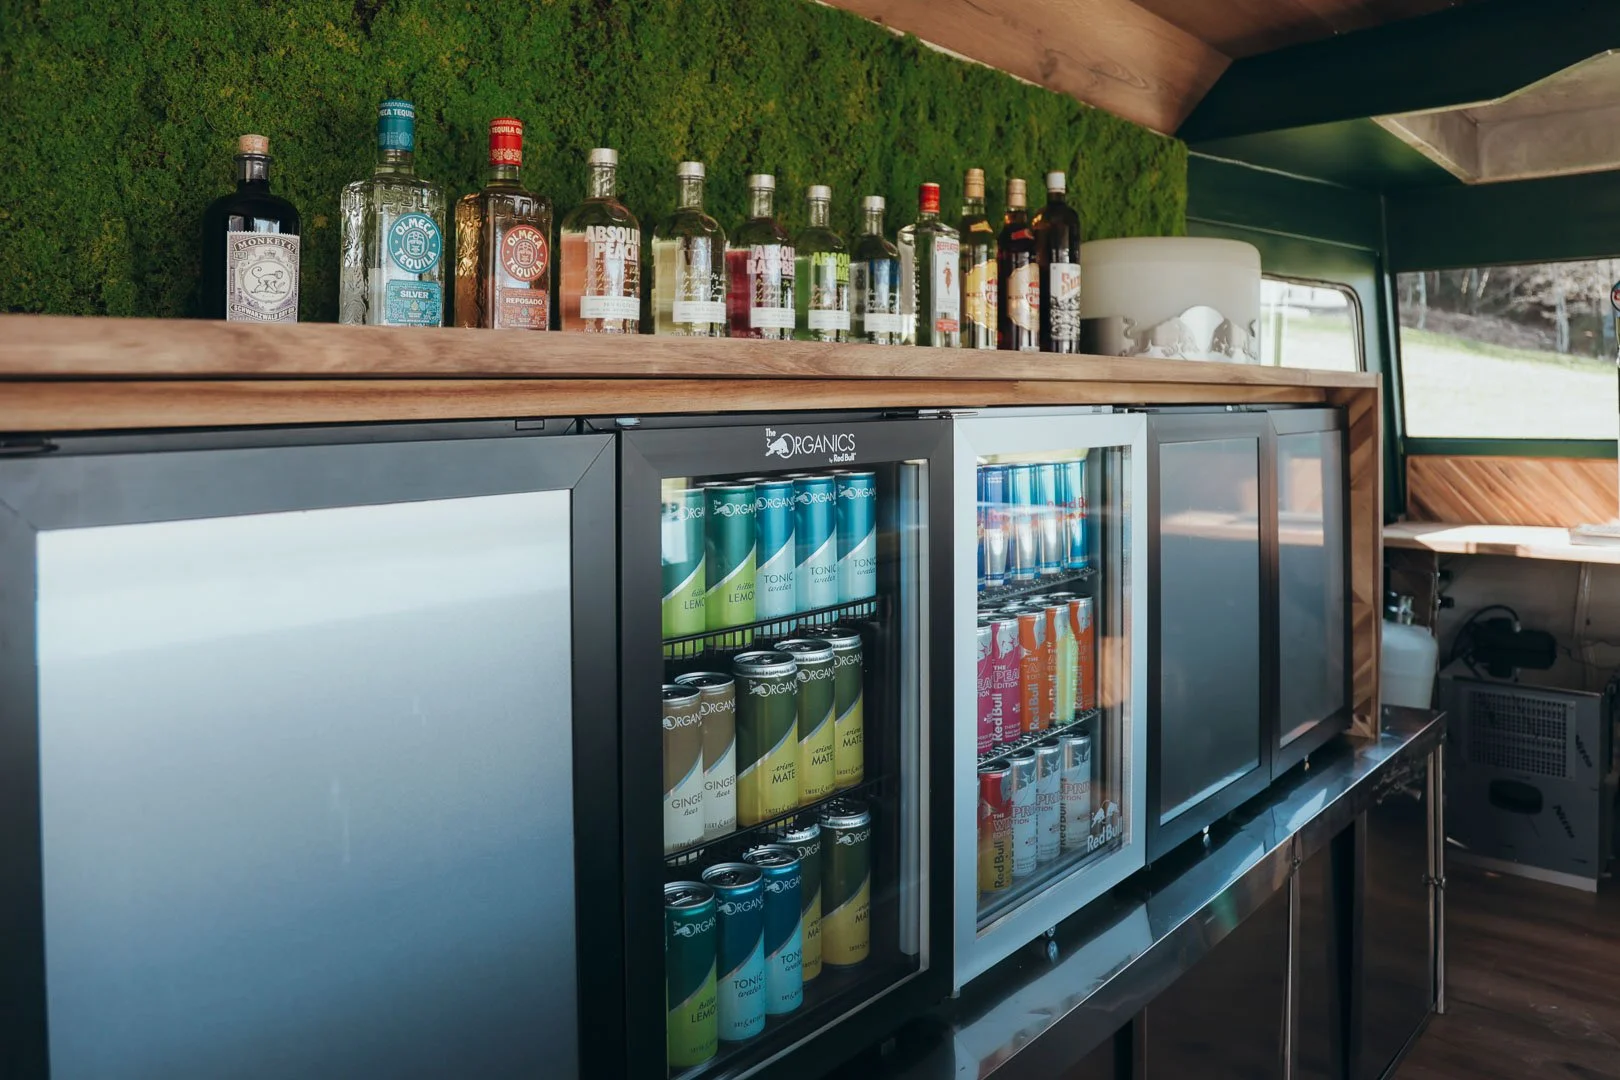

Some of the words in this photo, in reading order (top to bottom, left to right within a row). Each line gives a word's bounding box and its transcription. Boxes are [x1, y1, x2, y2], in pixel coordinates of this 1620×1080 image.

[395, 218, 436, 239] OLMECA
[238, 237, 286, 249] MONKEY
[507, 229, 543, 249] OLMECA
[395, 248, 436, 270] TEQUILA
[594, 242, 638, 261] PEACH
[506, 257, 544, 278] TEQUILA
[400, 290, 430, 299] SILVER
[505, 297, 543, 305] REPOSADO
[765, 428, 777, 437] The
[780, 433, 856, 459] ORGANICS
[834, 454, 845, 463] Red
[845, 452, 855, 462] Bull
[991, 693, 1003, 717] Bull
[991, 718, 1003, 741] Red
[811, 752, 834, 766] MATE
[772, 769, 796, 784] MATE
[1087, 826, 1105, 853] Red
[1106, 815, 1122, 841] Bull
[994, 840, 1004, 864] Bull
[994, 865, 1004, 889] Red
